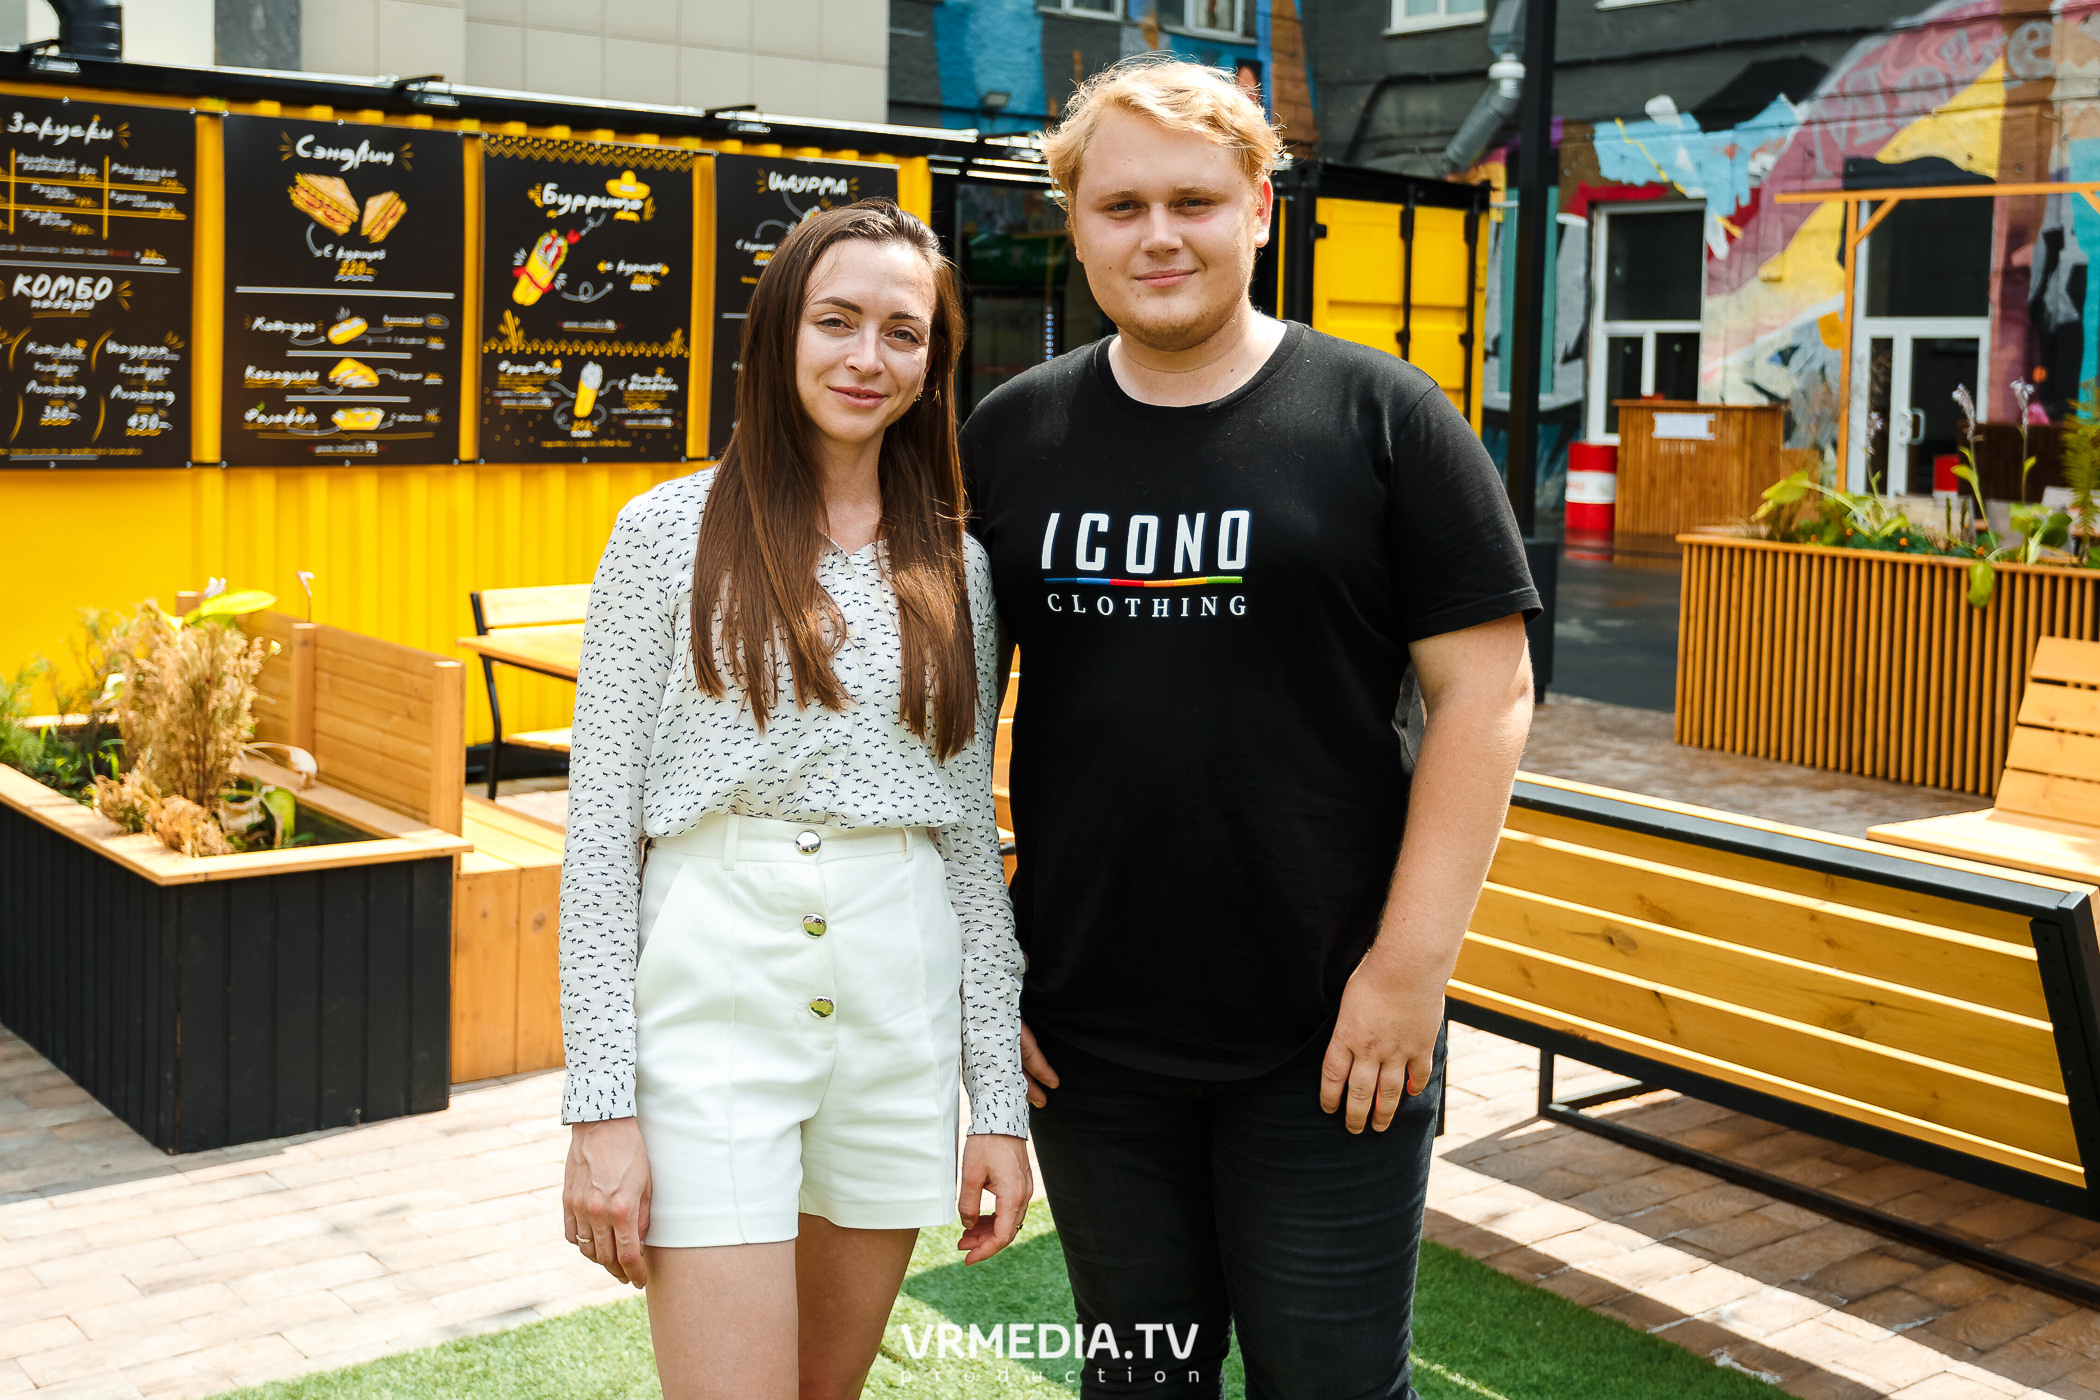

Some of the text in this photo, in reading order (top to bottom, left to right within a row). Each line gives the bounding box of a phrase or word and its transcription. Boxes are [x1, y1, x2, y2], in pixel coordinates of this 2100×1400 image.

[7, 111, 114, 146] Закуски
[296, 134, 394, 171] Сэндвич
[542, 182, 644, 216] Буррито
[12, 273, 114, 301] КОМБО
[31, 293, 95, 314] наборы
[1041, 510, 1250, 574] ICONO
[1047, 593, 1247, 618] CLOTHING
